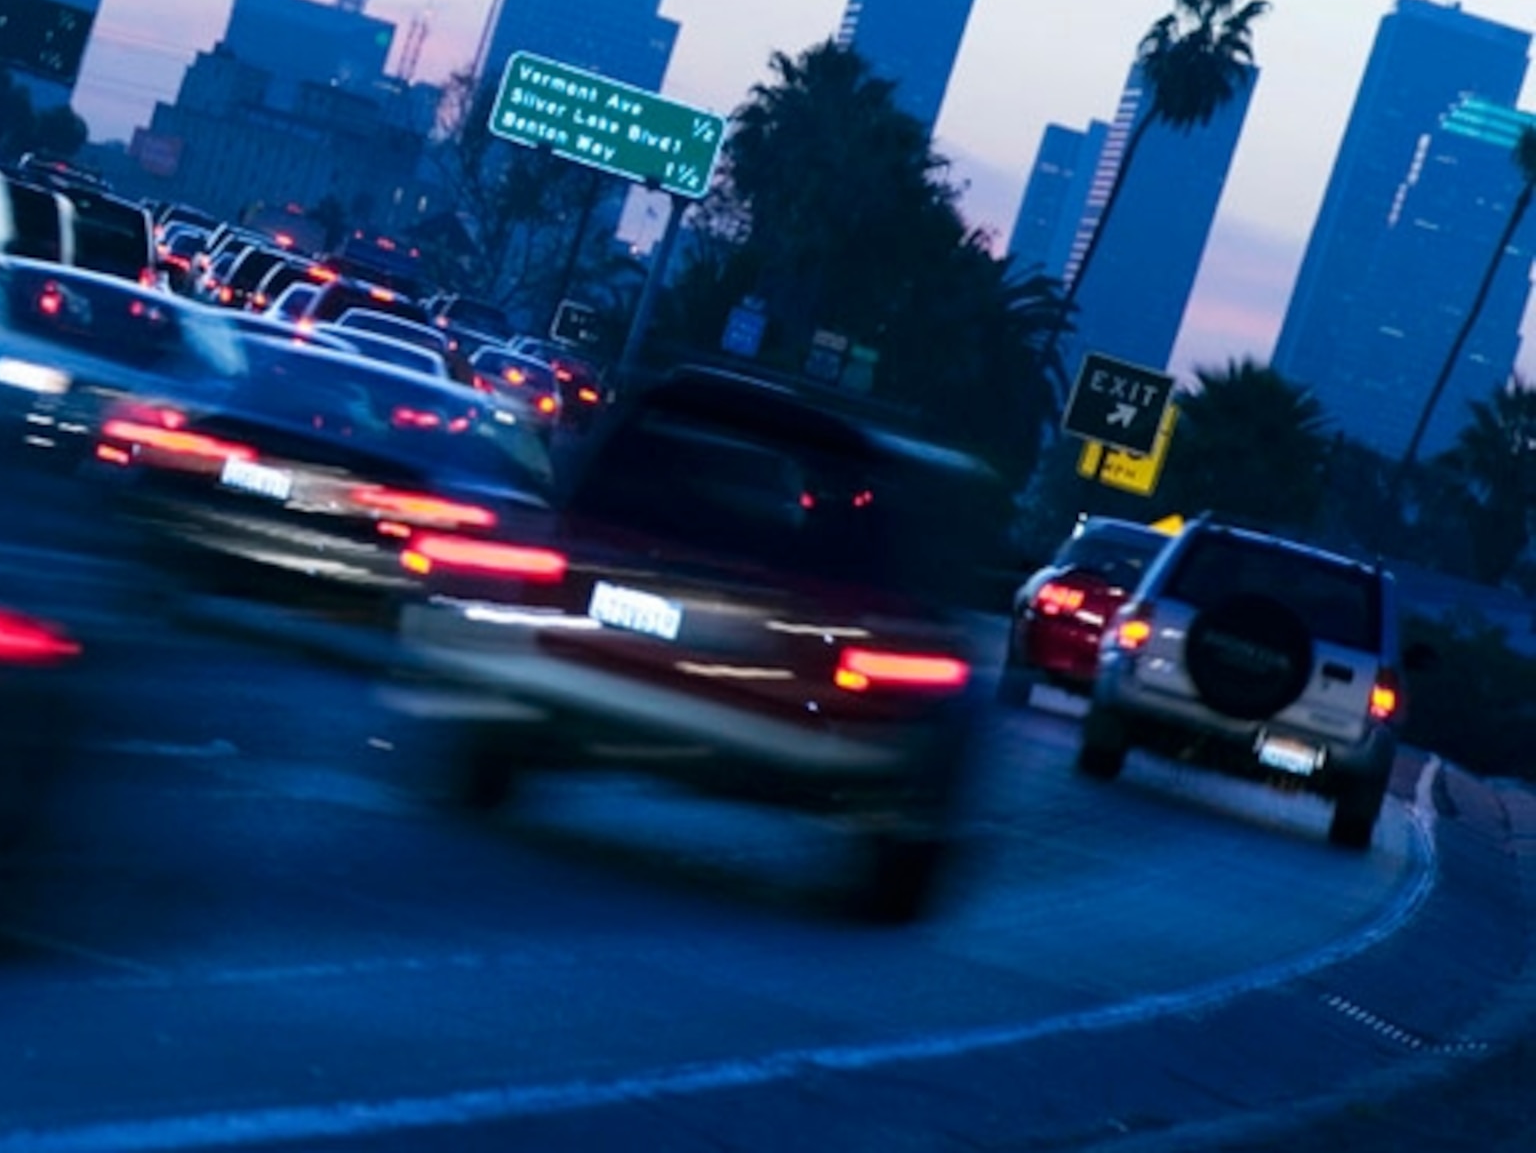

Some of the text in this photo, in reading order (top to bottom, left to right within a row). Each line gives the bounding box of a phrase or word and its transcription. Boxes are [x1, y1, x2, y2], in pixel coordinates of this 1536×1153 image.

[510, 87, 567, 117] Silver
[573, 109, 620, 133] Lake
[519, 64, 597, 102] Vermont
[605, 94, 643, 116] Ave
[502, 111, 569, 145] Benton
[575, 134, 616, 162] Way
[1090, 370, 1159, 407] EXIT
